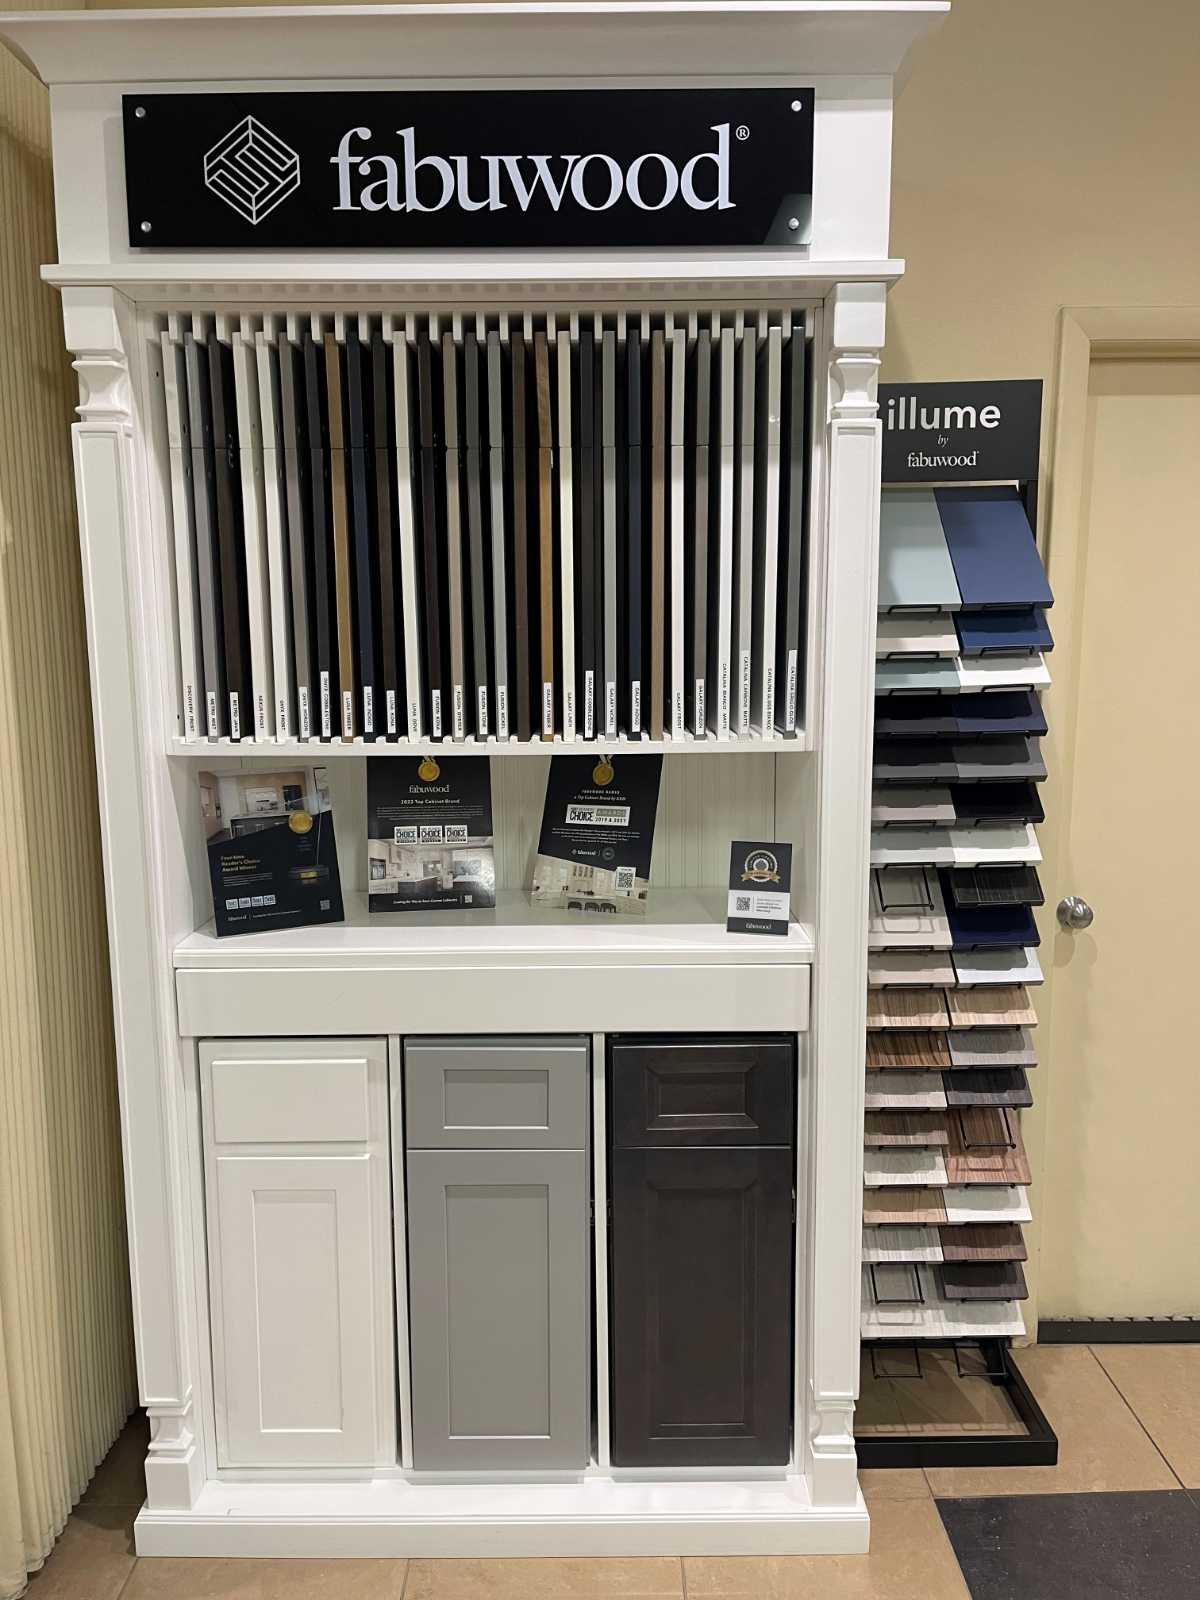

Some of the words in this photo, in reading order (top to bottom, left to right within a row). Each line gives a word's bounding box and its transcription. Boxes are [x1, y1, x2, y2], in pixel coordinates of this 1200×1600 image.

[888, 396, 1001, 430] illume
[937, 434, 949, 448] by
[907, 450, 978, 468] fabuwood
[409, 784, 450, 794] fabuwood
[570, 811, 594, 822] CHOICE
